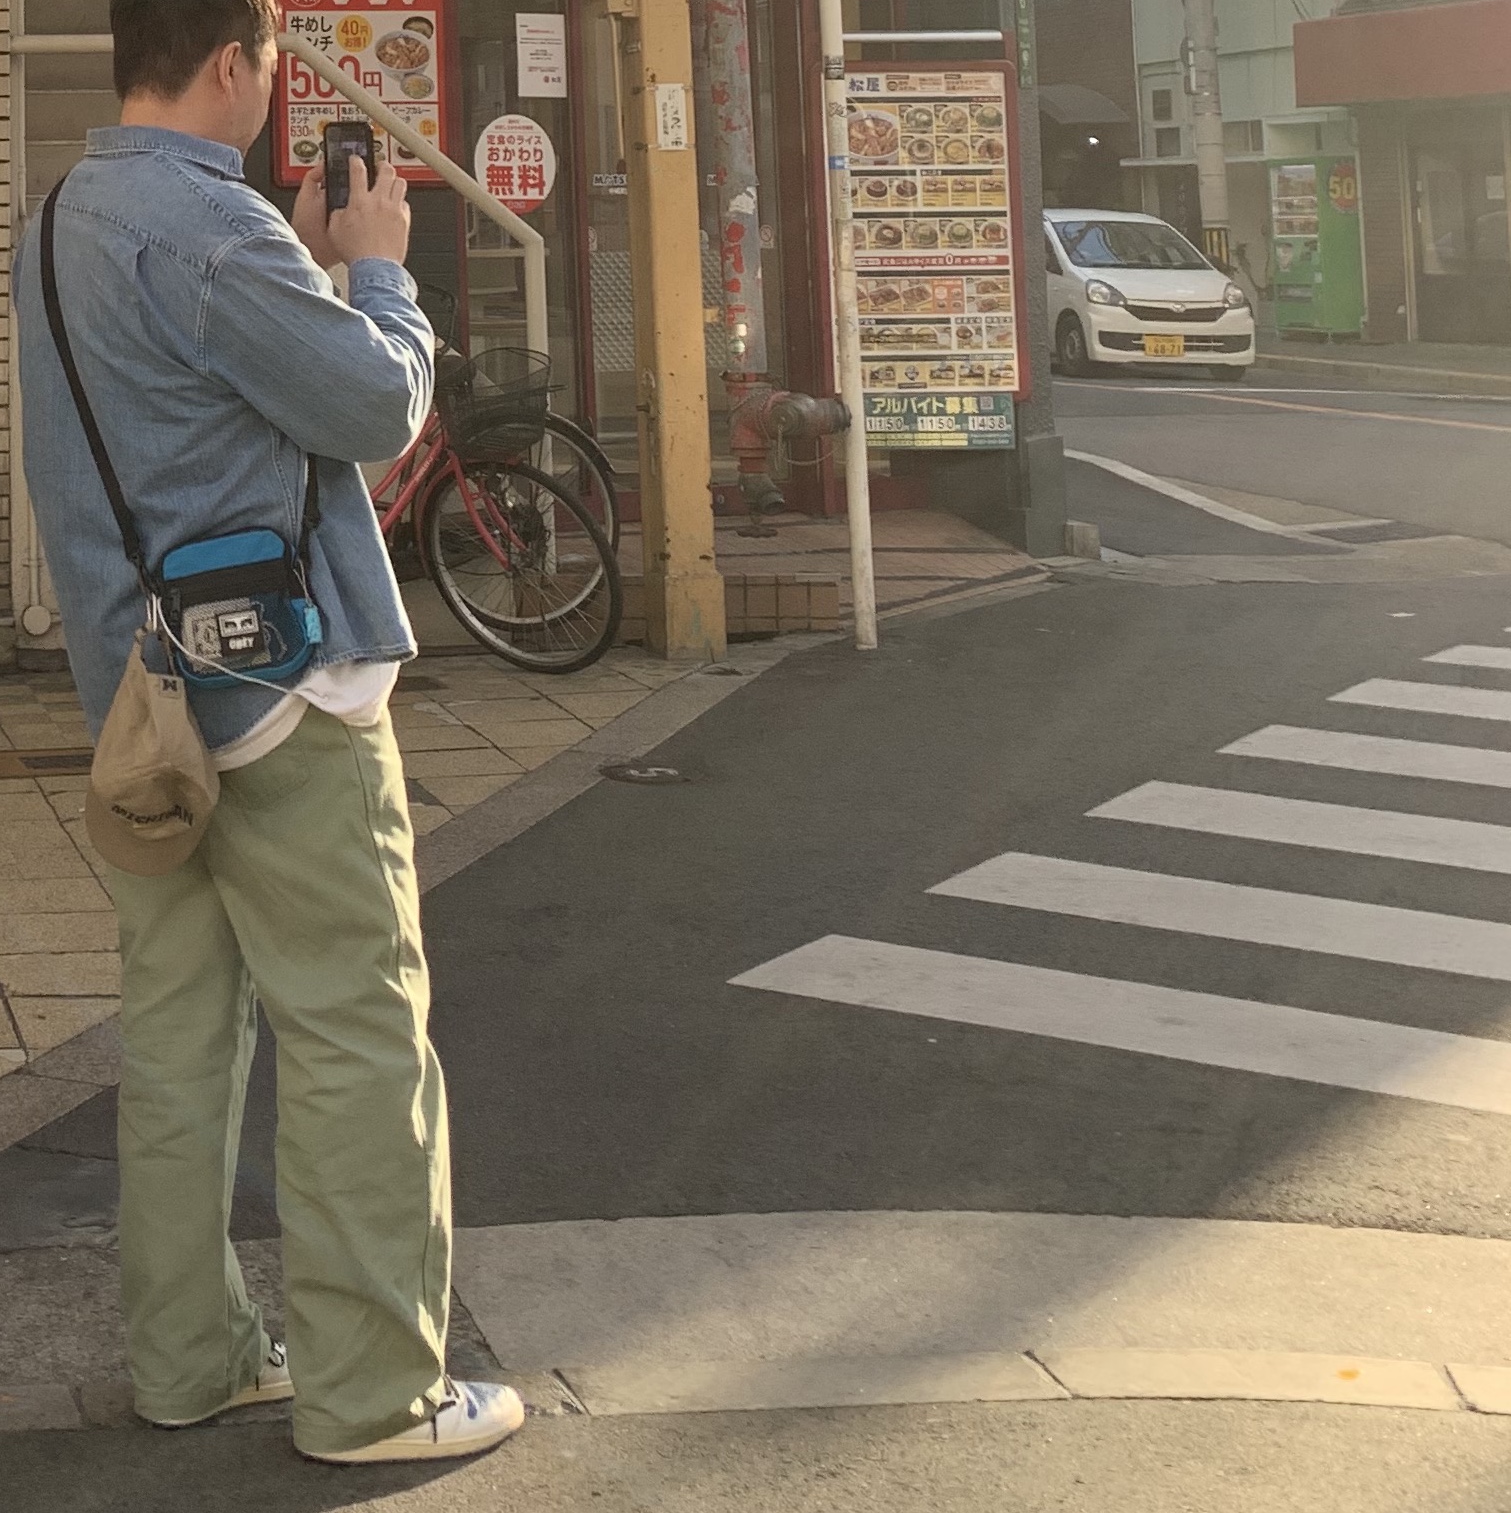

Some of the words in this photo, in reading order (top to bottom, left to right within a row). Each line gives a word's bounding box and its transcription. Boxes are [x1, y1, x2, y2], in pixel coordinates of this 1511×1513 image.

[290, 15, 334, 34] 牛めし
[340, 20, 370, 36] 40円
[848, 77, 881, 93] 松屋
[487, 146, 544, 162] おかわり
[485, 163, 546, 197] 無料
[1329, 175, 1357, 200] 50
[871, 396, 979, 415] アルバイト募集
